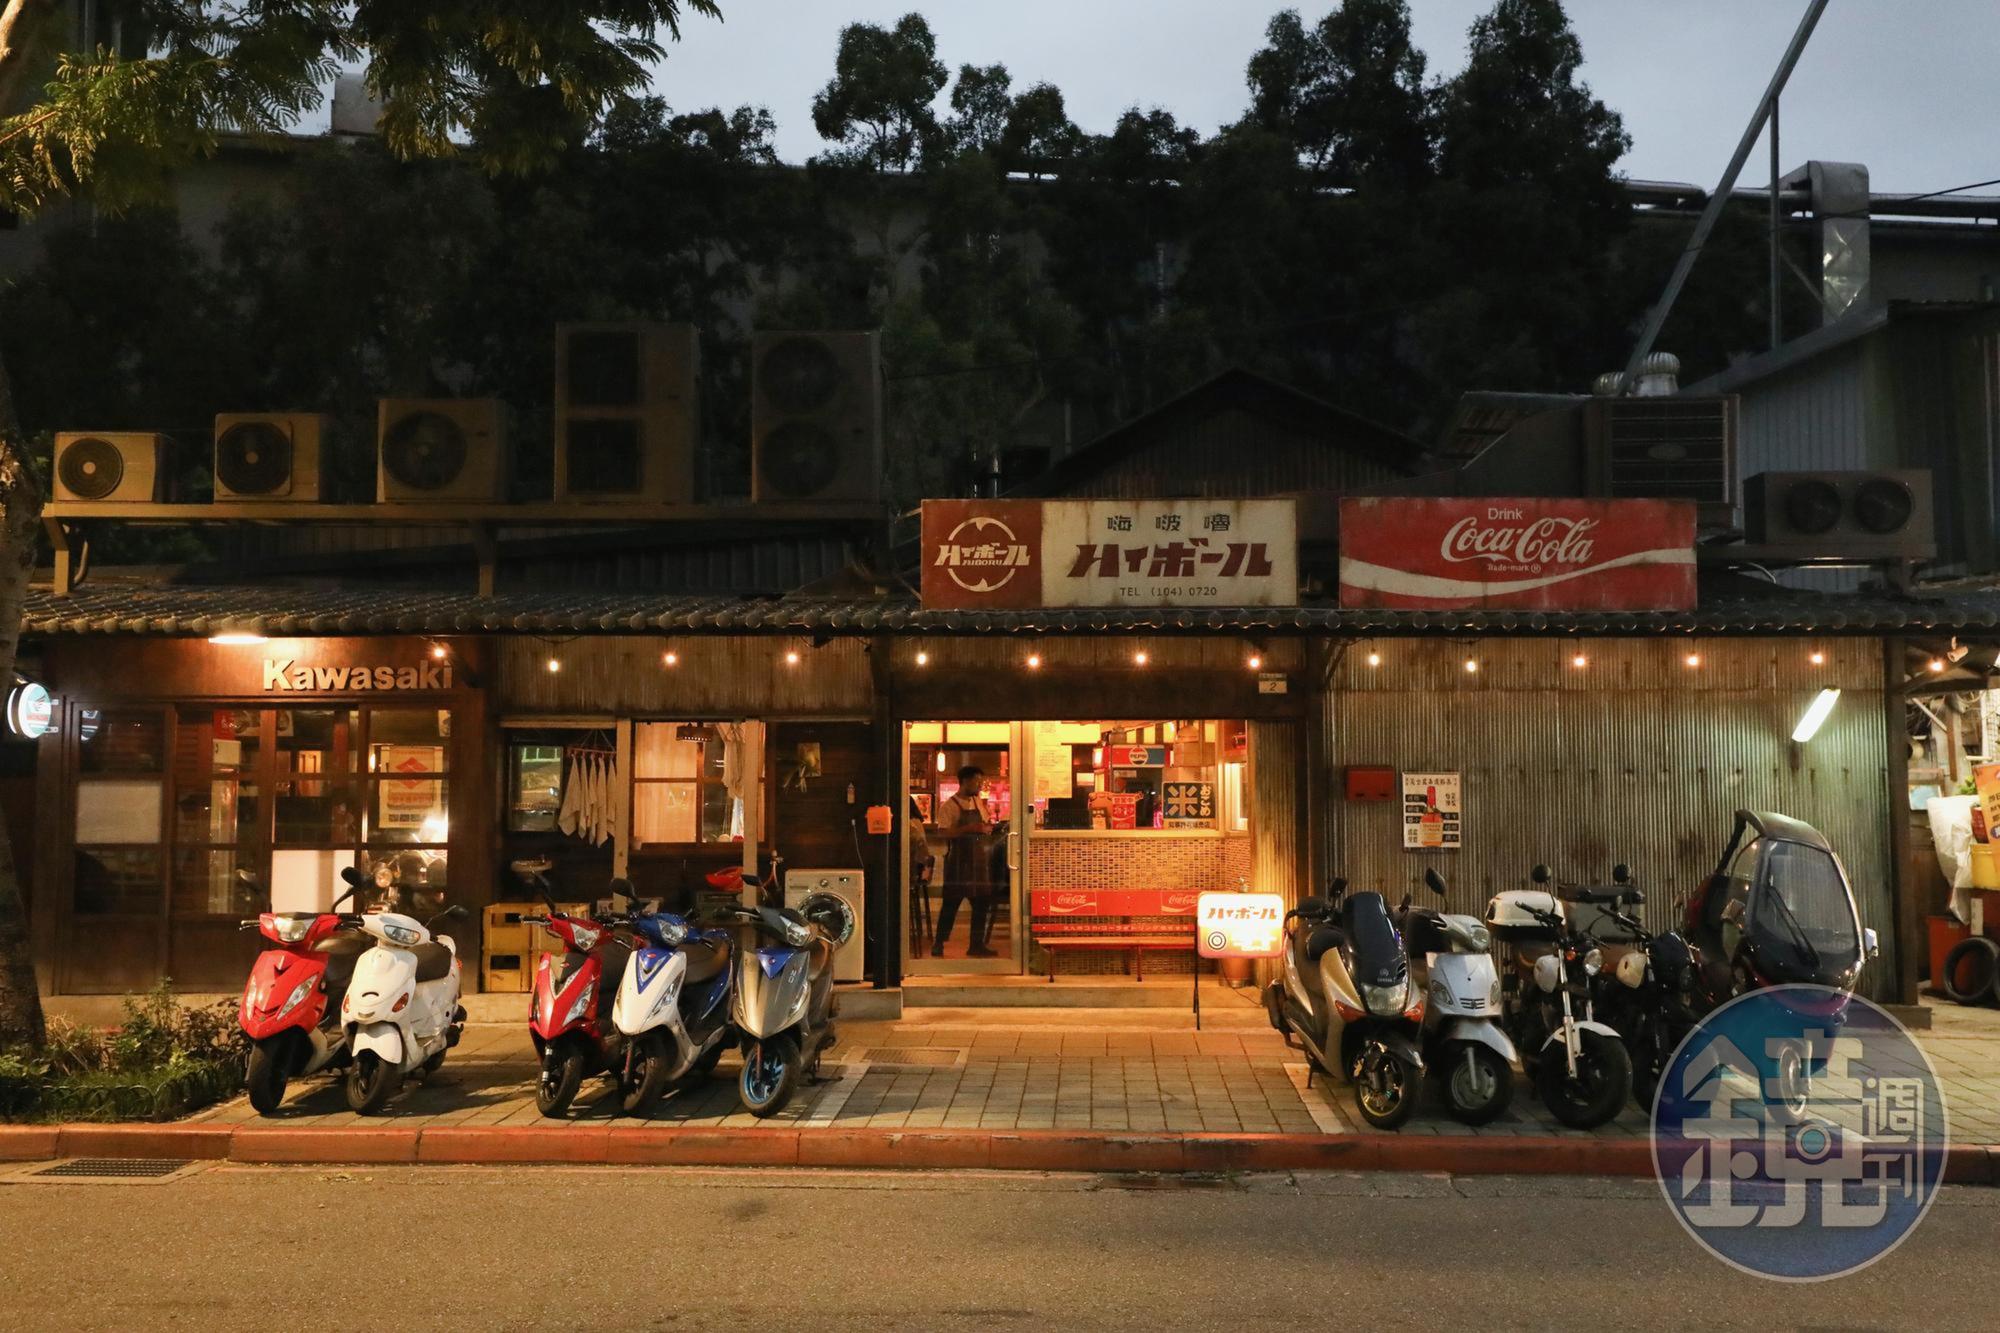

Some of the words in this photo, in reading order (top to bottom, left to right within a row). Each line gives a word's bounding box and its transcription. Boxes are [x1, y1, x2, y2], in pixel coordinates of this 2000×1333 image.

[1488, 507, 1523, 520] Drink
[1440, 517, 1600, 563] Coca-Cola
[934, 543, 1031, 566] ハイボール
[1066, 538, 1273, 577] ハイボール
[1119, 587, 1140, 596] TEL
[1150, 587, 1182, 597] (104)
[1189, 587, 1217, 596] 0720
[263, 659, 453, 690] Kawasaki
[1270, 682, 1277, 691] 2
[1167, 785, 1198, 816] 米
[1199, 784, 1212, 816] おこめ
[1057, 895, 1087, 905] Coca-Cola
[1207, 905, 1277, 919] ハイボール
